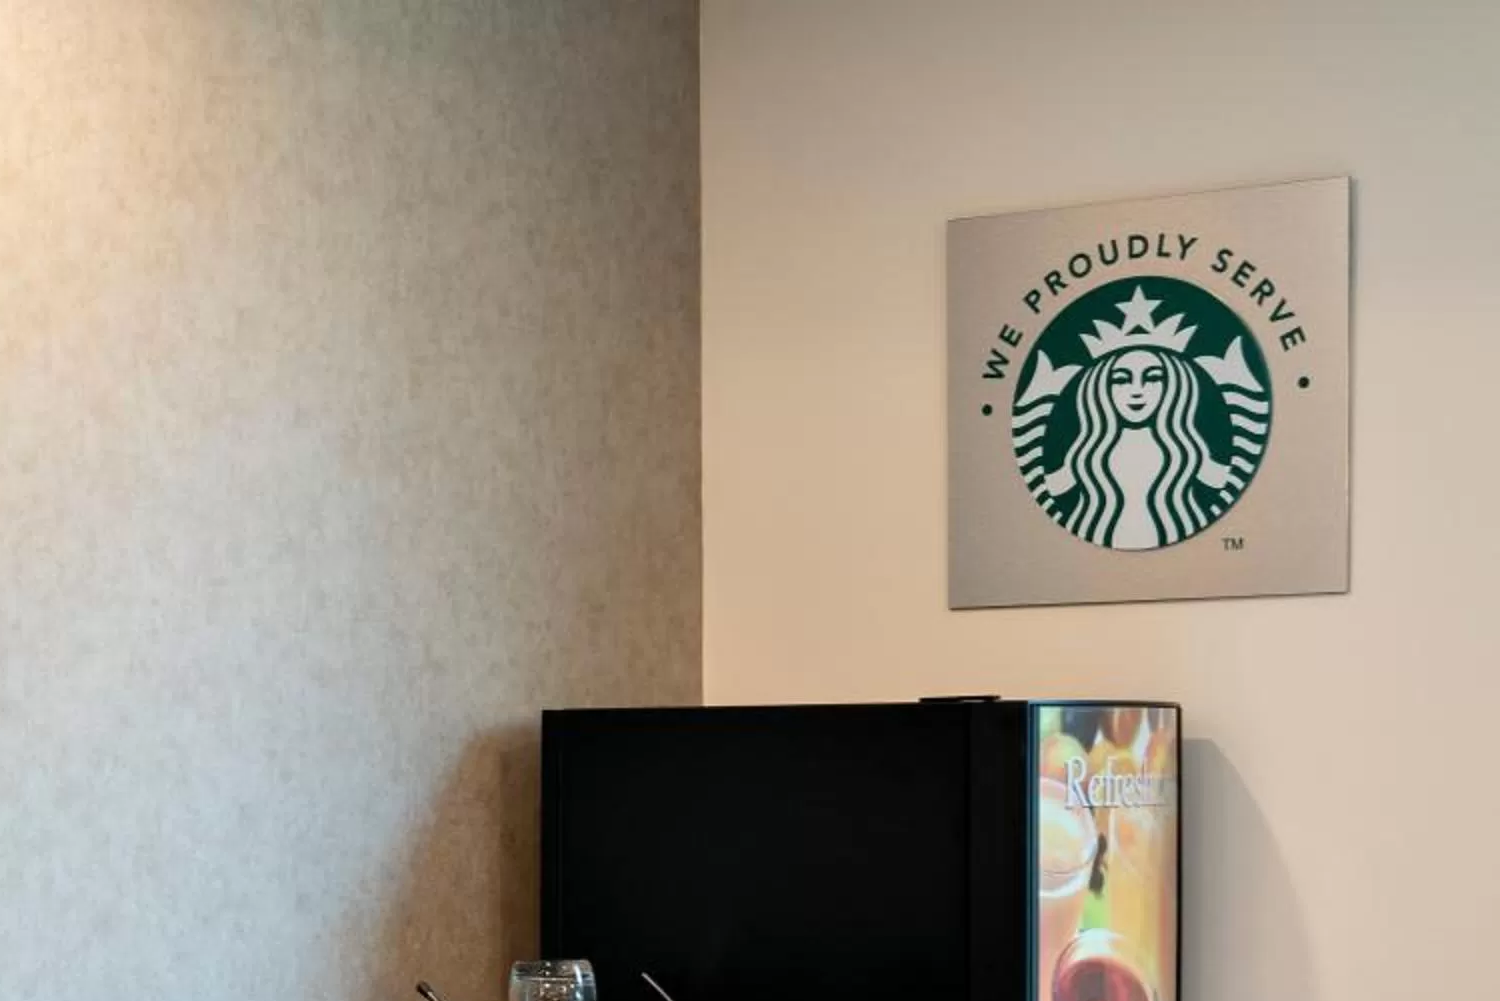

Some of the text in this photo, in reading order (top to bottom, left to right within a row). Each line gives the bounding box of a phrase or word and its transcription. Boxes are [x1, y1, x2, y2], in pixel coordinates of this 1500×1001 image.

[982, 233, 1307, 381] WE PROUDLY SERVE
[1221, 537, 1244, 551] TM
